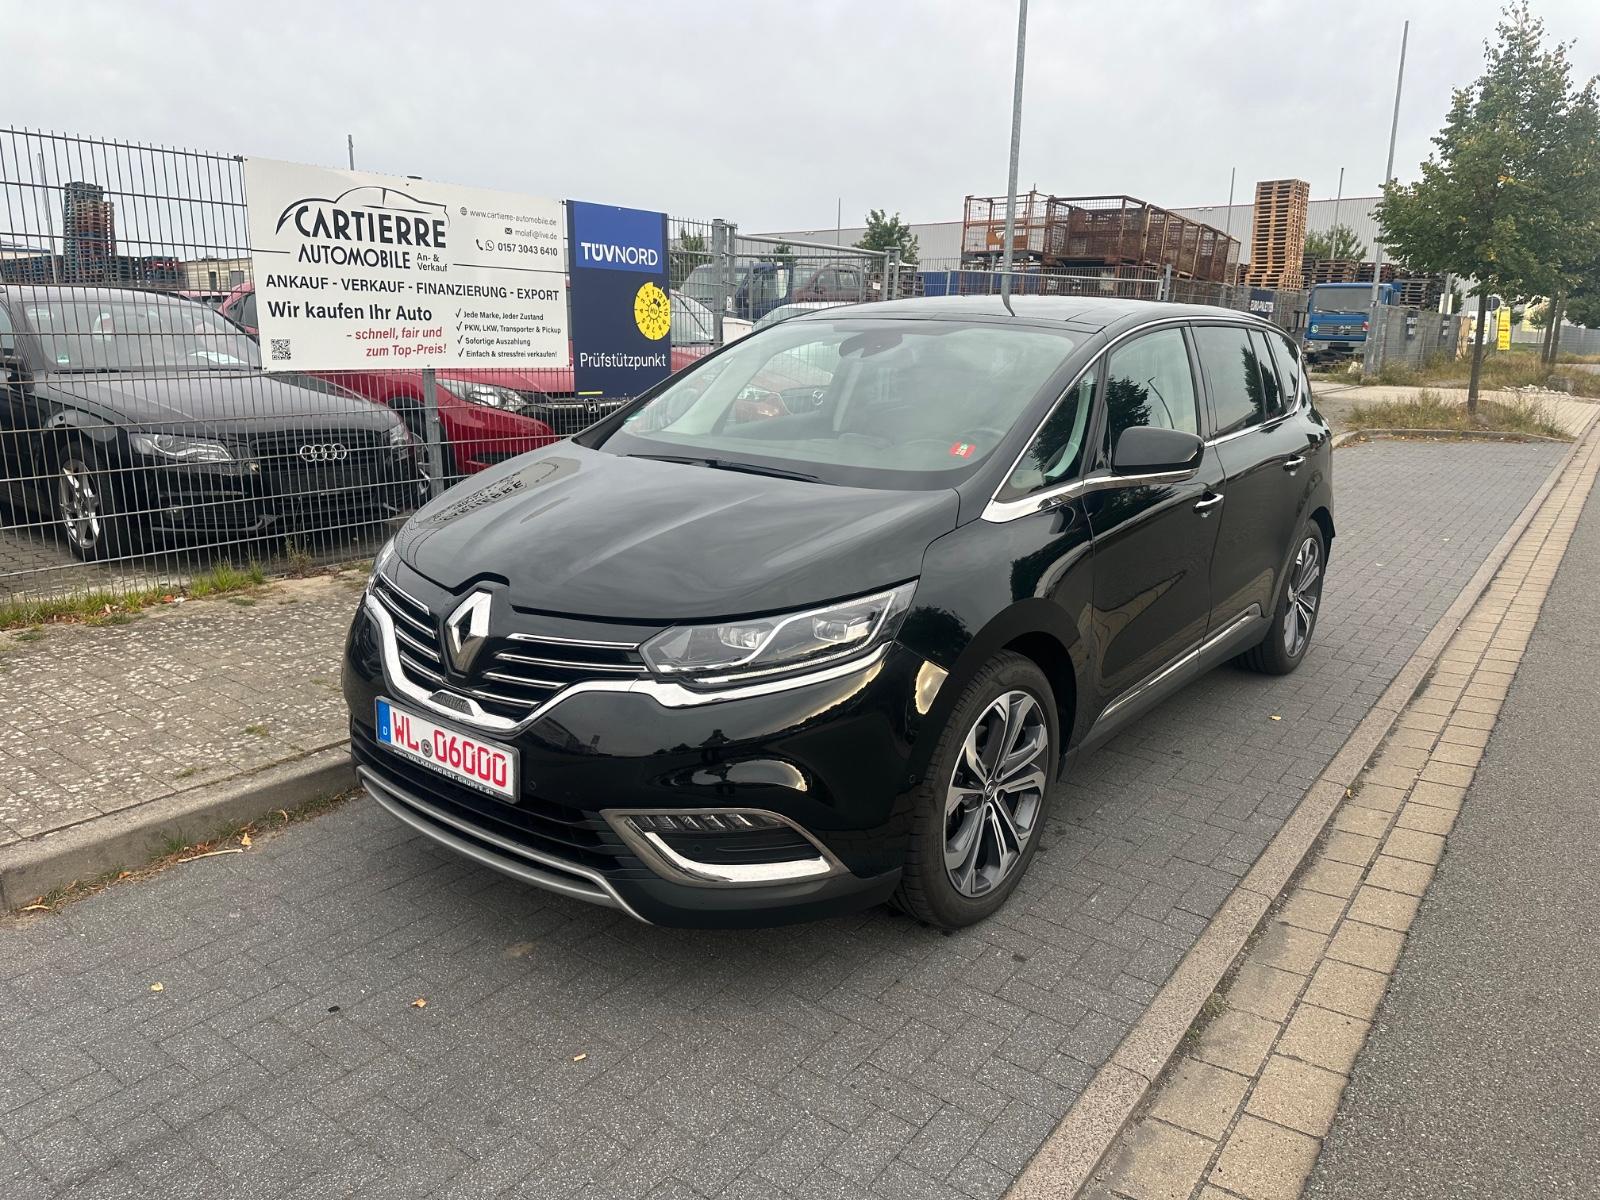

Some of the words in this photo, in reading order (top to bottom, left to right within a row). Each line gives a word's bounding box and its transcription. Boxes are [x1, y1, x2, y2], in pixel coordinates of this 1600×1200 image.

[295, 205, 446, 248] CARTIERRE
[298, 243, 410, 269] AUTOMOBILE
[497, 242, 516, 252] 0157
[518, 244, 538, 254] 3043
[540, 246, 558, 256] 6410
[417, 253, 431, 262] An-
[433, 254, 440, 262] &
[417, 263, 448, 272] Verkauf
[266, 274, 329, 290] ANKAUF
[341, 278, 404, 292] VERKAUF
[416, 282, 506, 298] FINANZIERUNG
[517, 288, 559, 301] EXPORT
[268, 301, 300, 318] Wir
[305, 302, 364, 319] kaufen
[370, 304, 391, 319] Ihr
[396, 306, 432, 321] Auto
[355, 327, 399, 340] schnell,
[401, 327, 419, 338] fair
[423, 326, 442, 338] und
[464, 324, 481, 332] PKW,
[500, 325, 534, 333] Transporter
[465, 337, 494, 345] Sofortige
[496, 338, 530, 346] Auszahlung
[366, 346, 388, 357] zum
[392, 344, 446, 358] Top-Preis!
[580, 352, 666, 370] Prüfstützpunkt
[383, 726, 388, 736] D
[393, 712, 419, 752] WL
[434, 729, 506, 788] 06000
